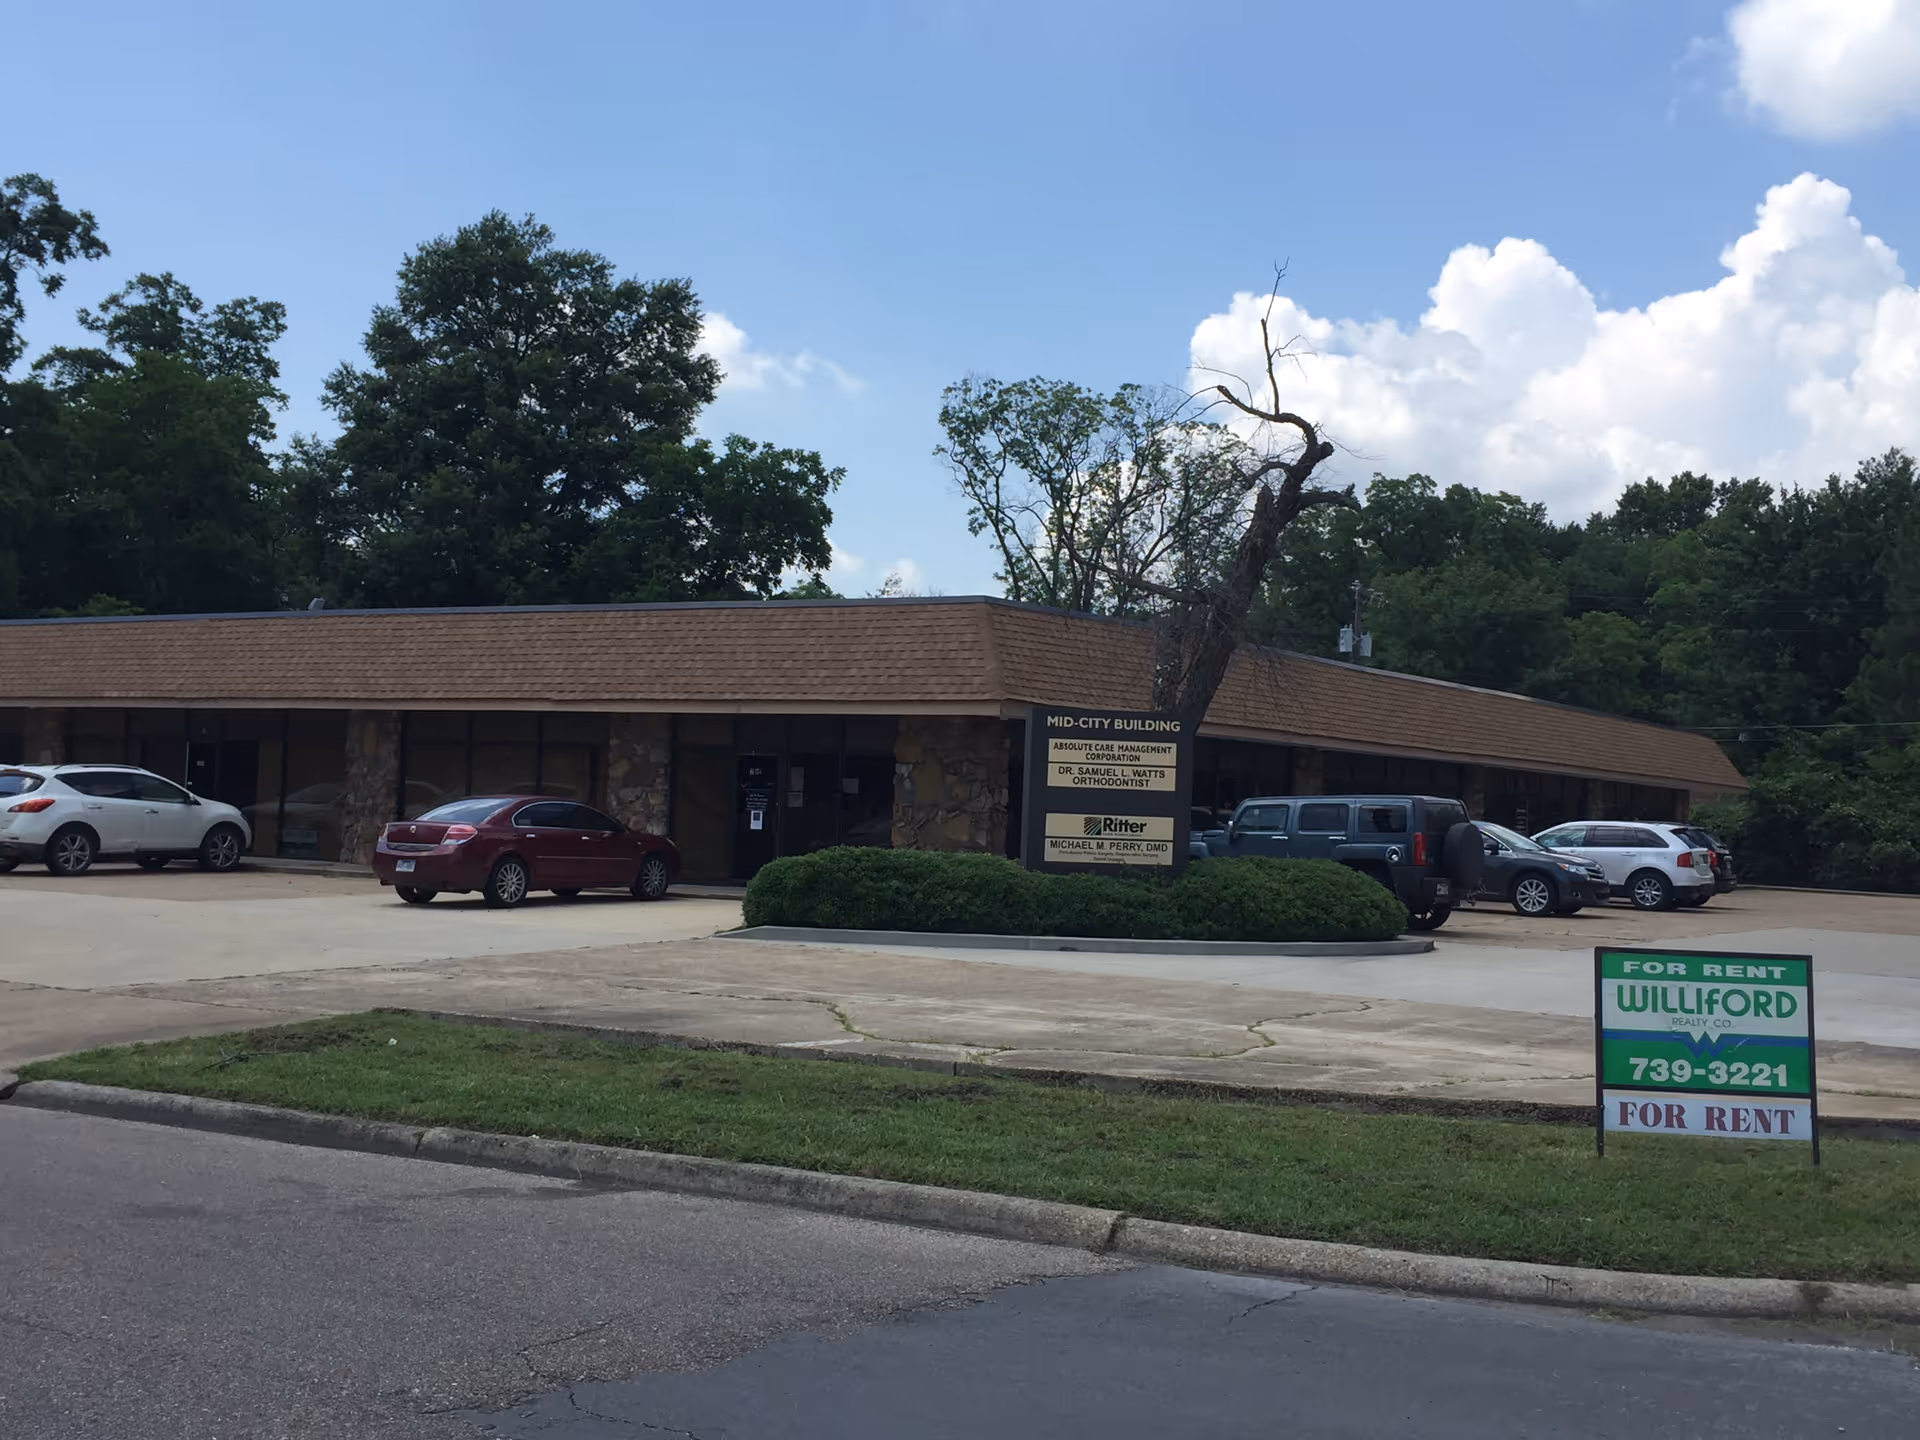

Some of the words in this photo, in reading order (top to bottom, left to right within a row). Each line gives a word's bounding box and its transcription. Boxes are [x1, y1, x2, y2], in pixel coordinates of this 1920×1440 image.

[1047, 716, 1111, 729] MID-CITY
[1114, 719, 1180, 732] BUILDING
[1053, 742, 1093, 752] ABSOLUTE
[1094, 743, 1114, 752] CARE
[1118, 744, 1172, 754] MANAGEMENT
[1085, 753, 1140, 762] CORPORATION
[1058, 766, 1075, 775] DR.
[1078, 767, 1118, 777] SAMUEL
[1121, 768, 1130, 778] L.
[1132, 769, 1166, 779] WATTS
[1072, 776, 1150, 788] ORTHODONTIST
[1103, 817, 1147, 834] Ritter
[1050, 840, 1093, 850] MICHAEL
[1096, 841, 1106, 850] M.
[1109, 841, 1144, 852] PERRY,
[1146, 842, 1168, 852] DMD
[1623, 961, 1687, 975] FOR
[1702, 963, 1786, 979] RENT
[1672, 1017, 1708, 1027] REALTY
[1629, 1057, 1787, 1087] 739-3221
[1618, 1101, 1688, 1129] FOR
[1704, 1105, 1796, 1134] RENT
